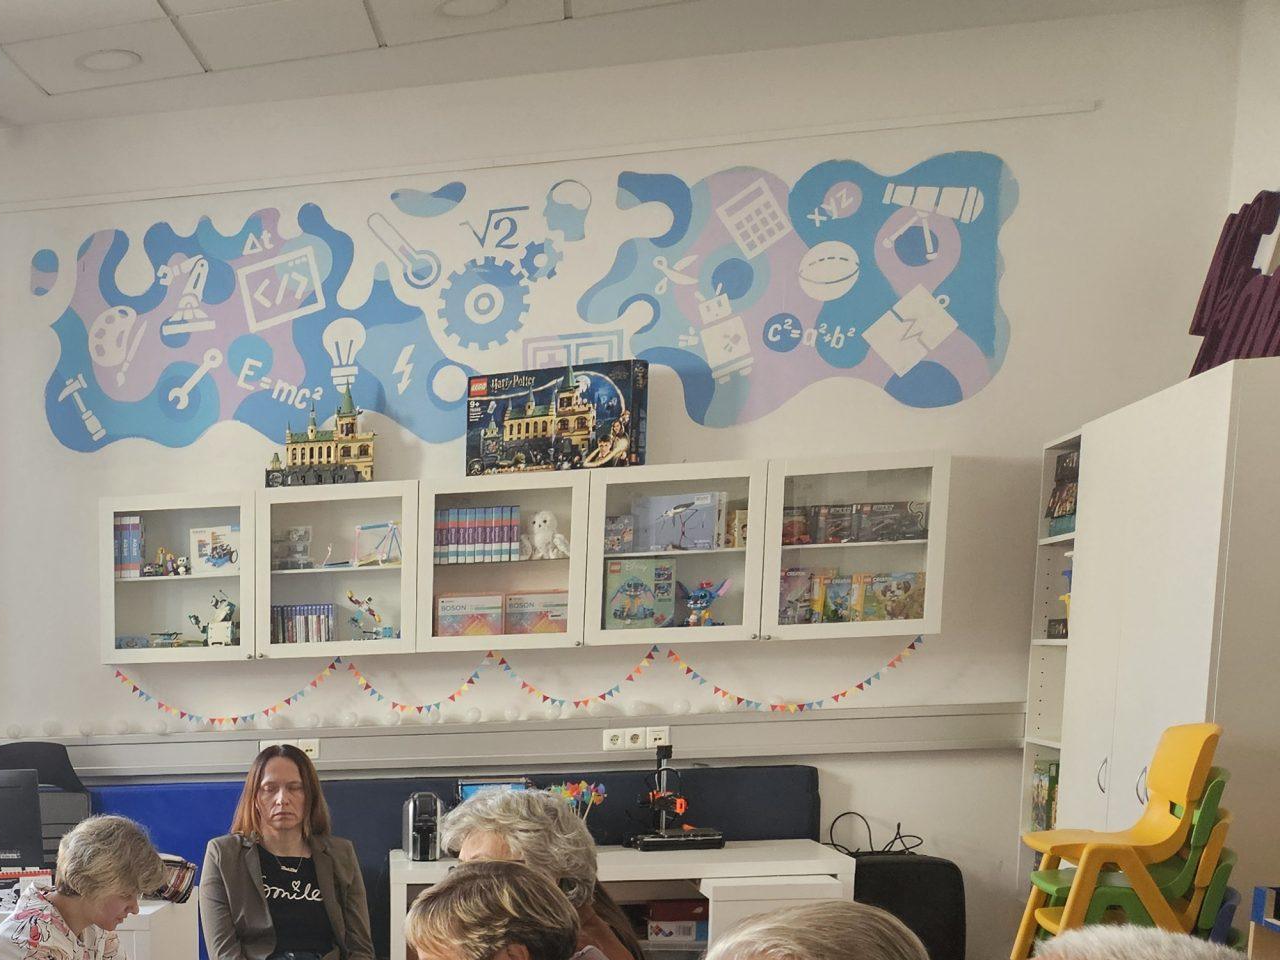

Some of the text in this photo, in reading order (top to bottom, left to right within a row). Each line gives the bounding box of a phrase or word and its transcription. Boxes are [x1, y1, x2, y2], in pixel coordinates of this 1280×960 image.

[490, 377, 512, 394] Harry
[513, 374, 536, 388] Potter
[440, 604, 467, 612] BOSON
[508, 602, 535, 610] BOSON
